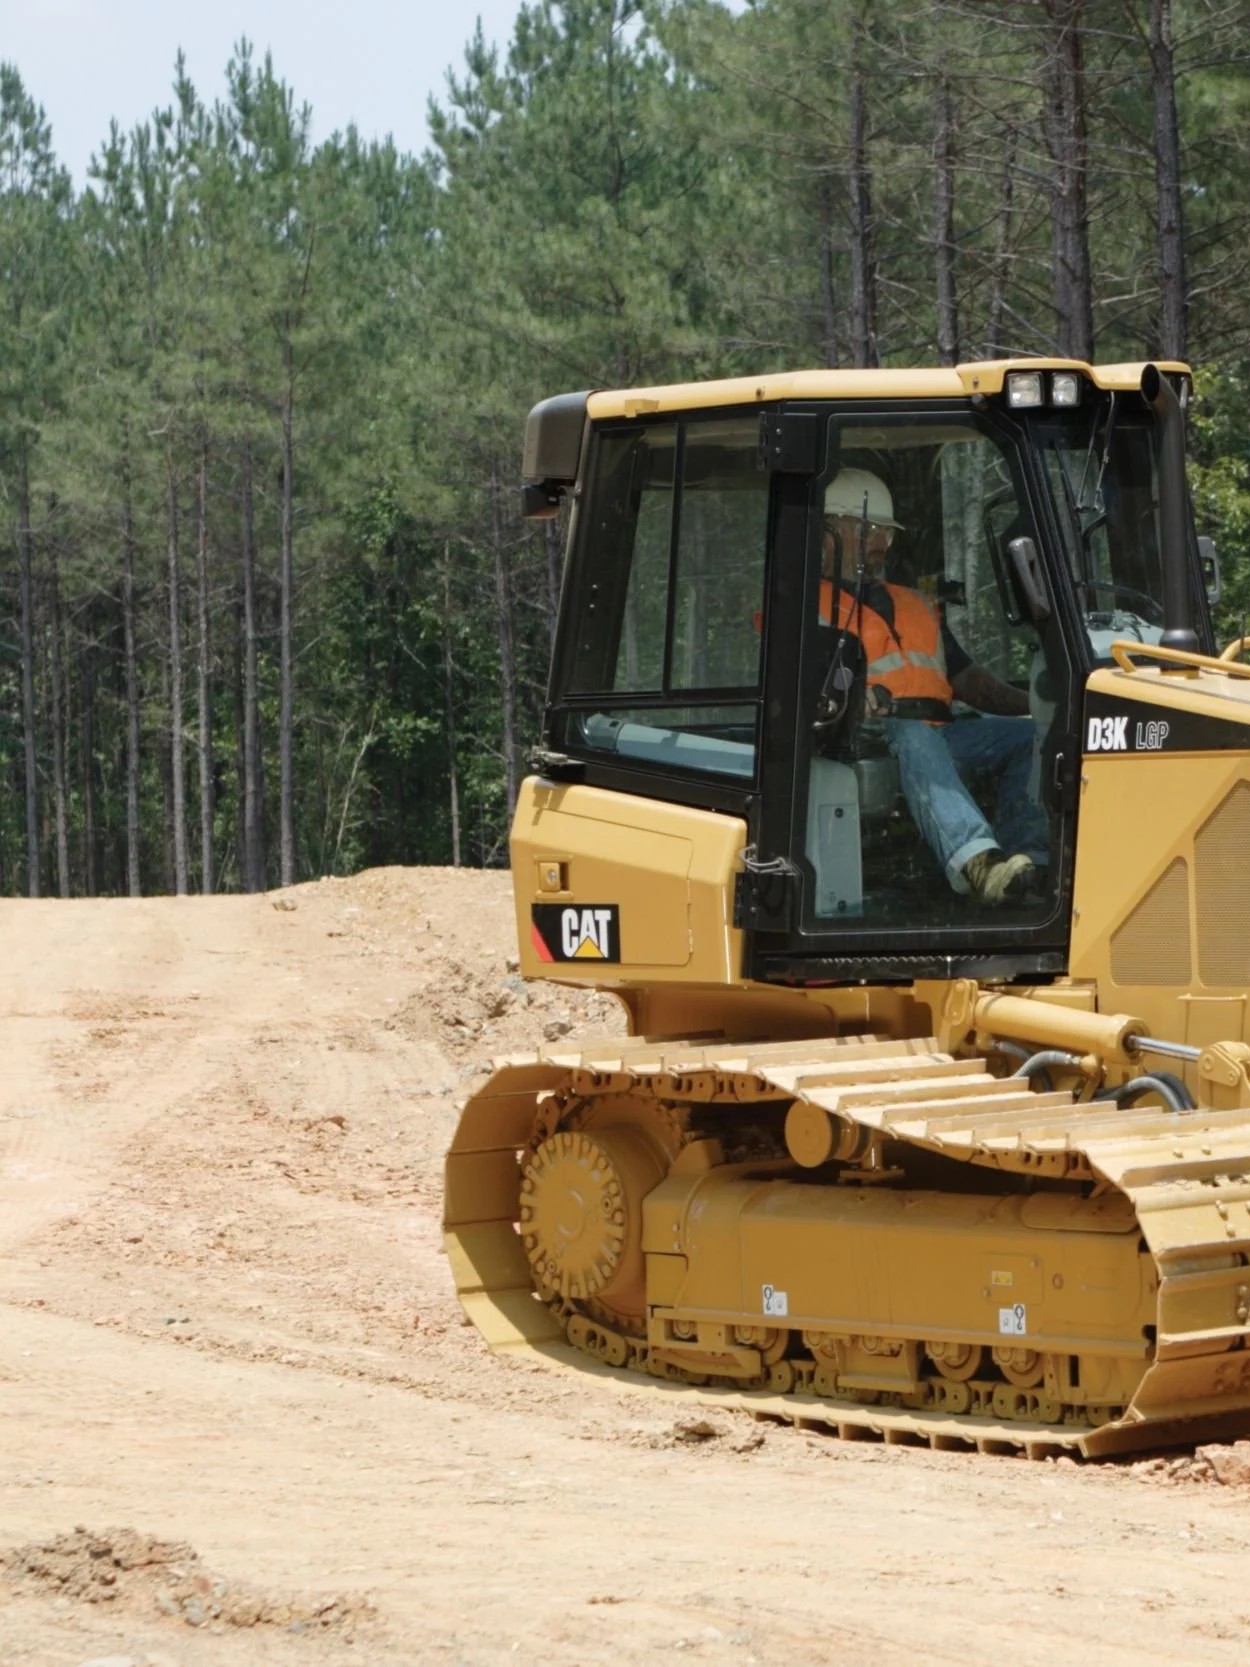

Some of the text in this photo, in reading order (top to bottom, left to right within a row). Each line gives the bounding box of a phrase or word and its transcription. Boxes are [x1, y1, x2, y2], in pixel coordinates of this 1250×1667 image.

[1087, 716, 1169, 751] D3K LGP
[561, 908, 612, 958] CAT
